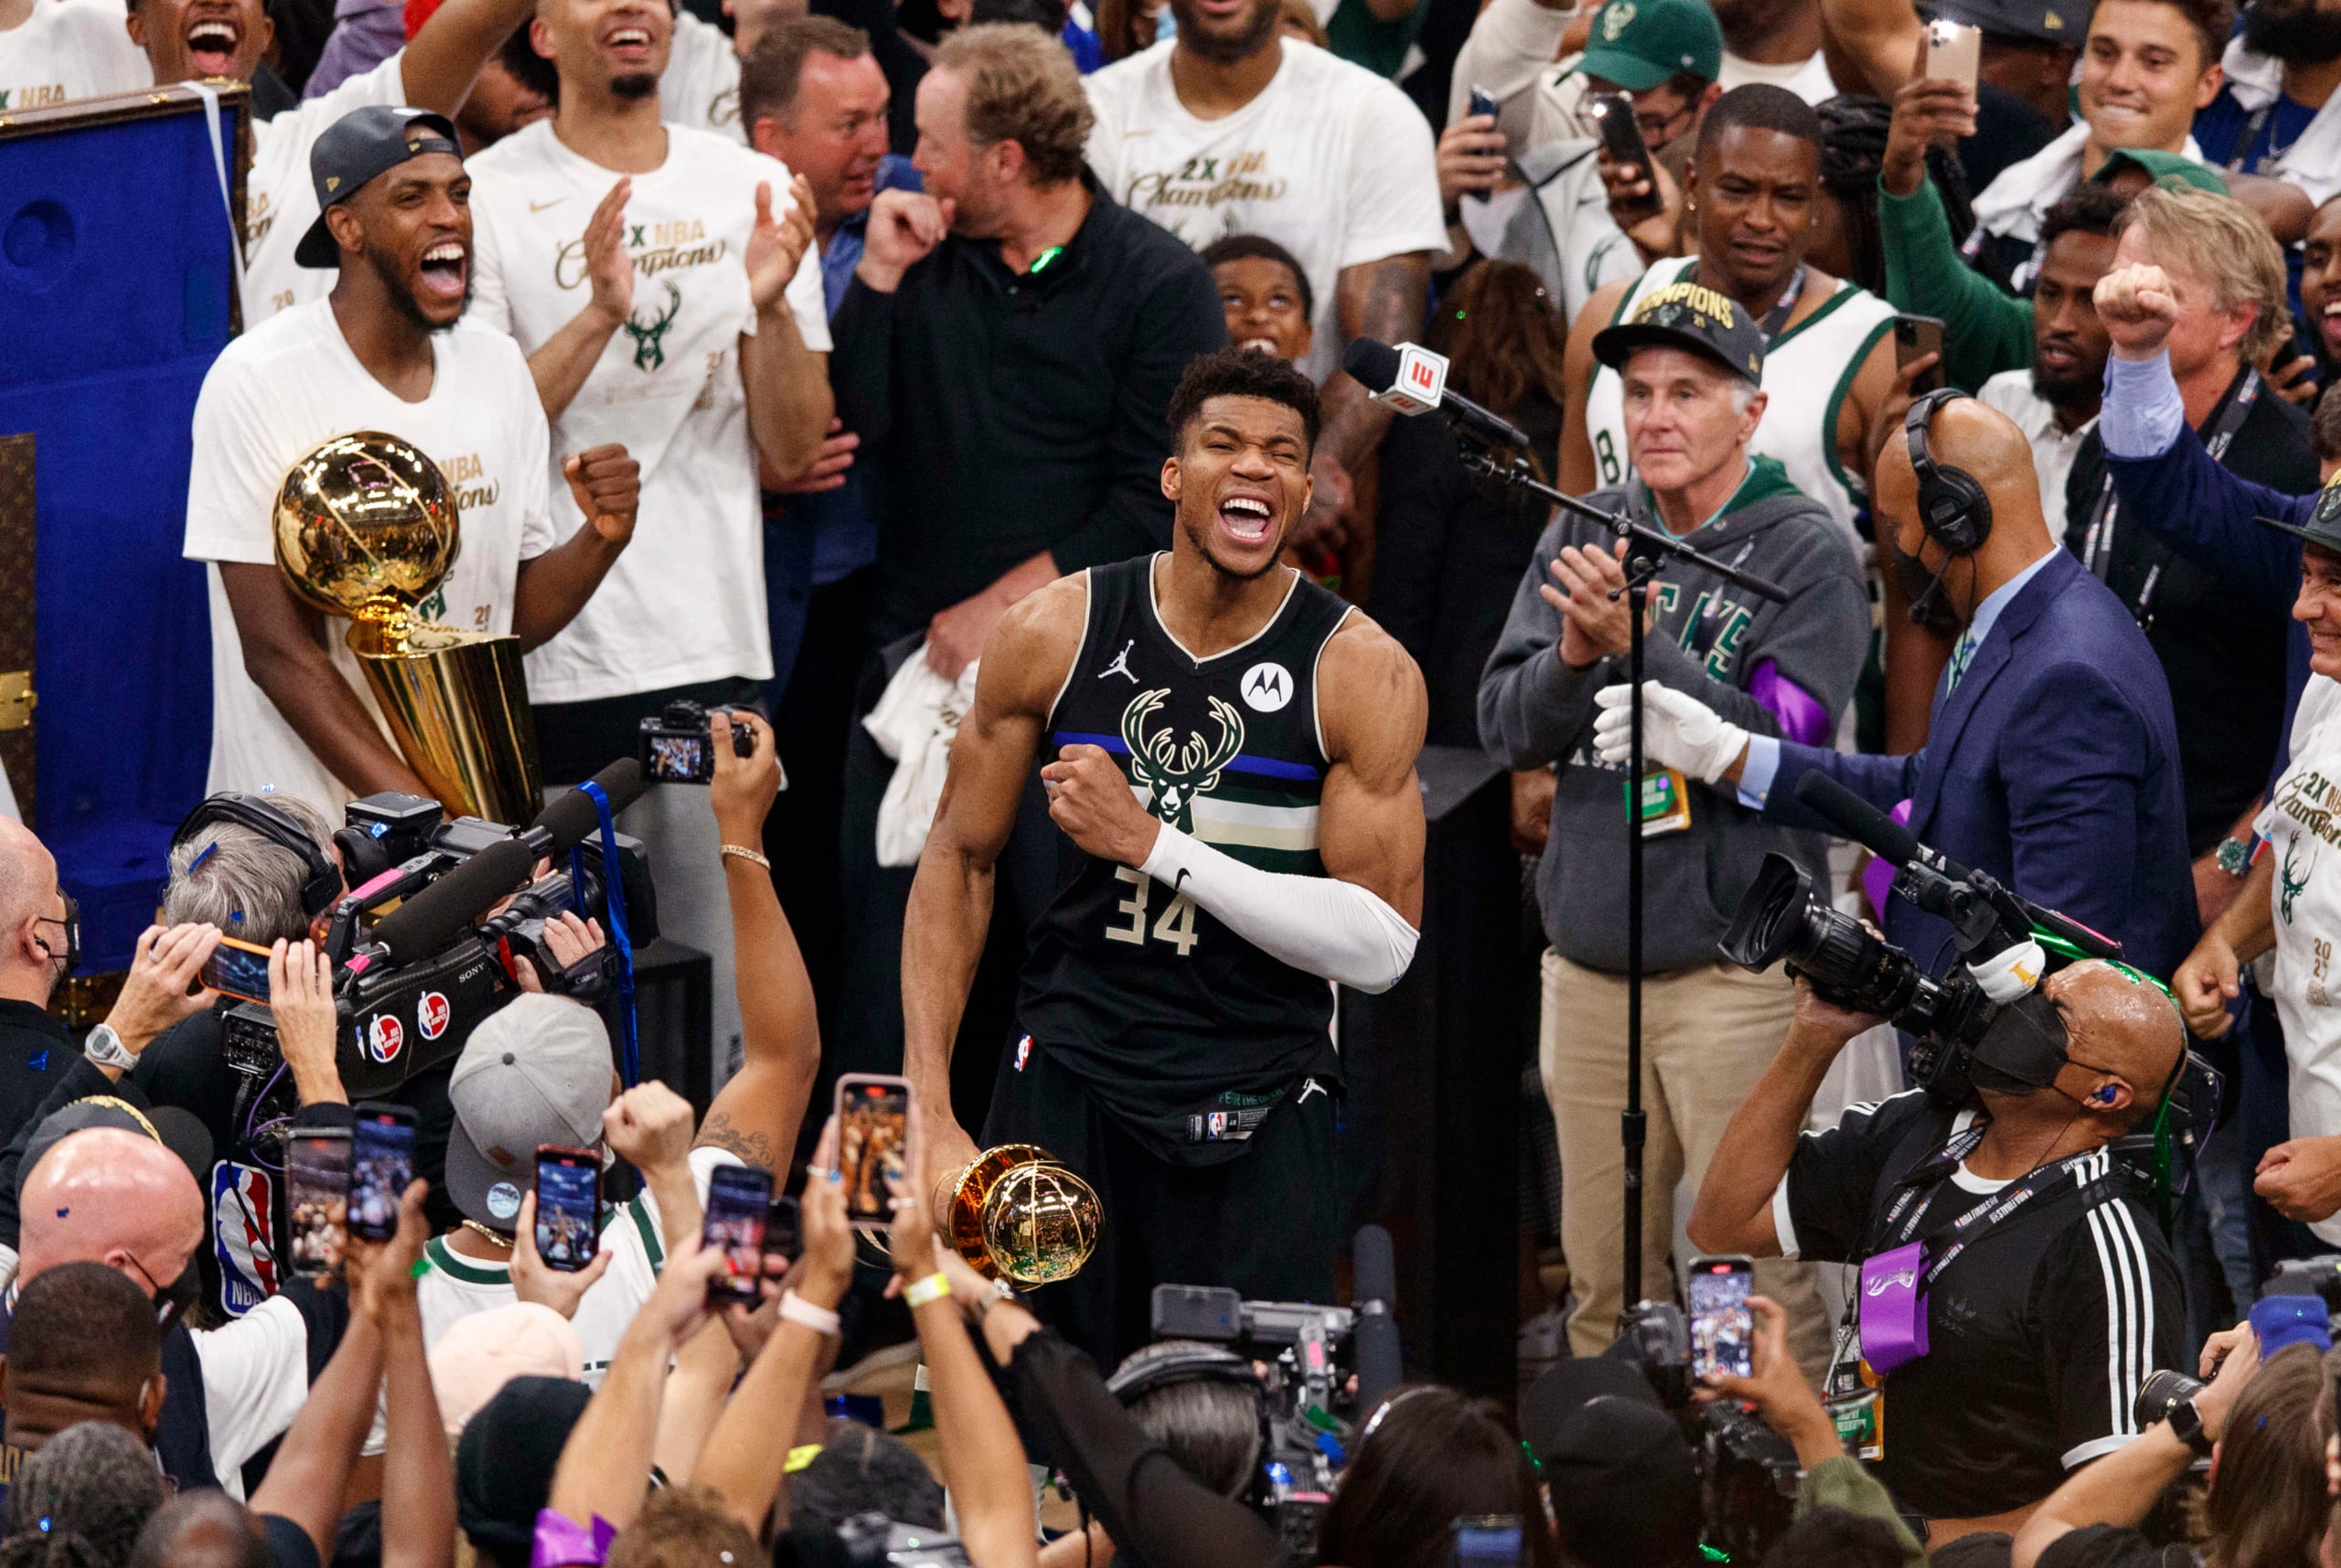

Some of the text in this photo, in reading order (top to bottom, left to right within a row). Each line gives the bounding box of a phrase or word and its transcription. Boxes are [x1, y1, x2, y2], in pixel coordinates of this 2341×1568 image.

[655, 219, 705, 245] NBA
[2302, 772, 2330, 803] 2X
[1106, 865, 1198, 955] 34
[2314, 937, 2332, 960] 20
[458, 962, 485, 983] SONY
[1995, 1199, 2018, 1220] FINALS
[2015, 1190, 2029, 1205] NBA
[1958, 1212, 1974, 1227] NBA
[1970, 1200, 1993, 1219] FINALS
